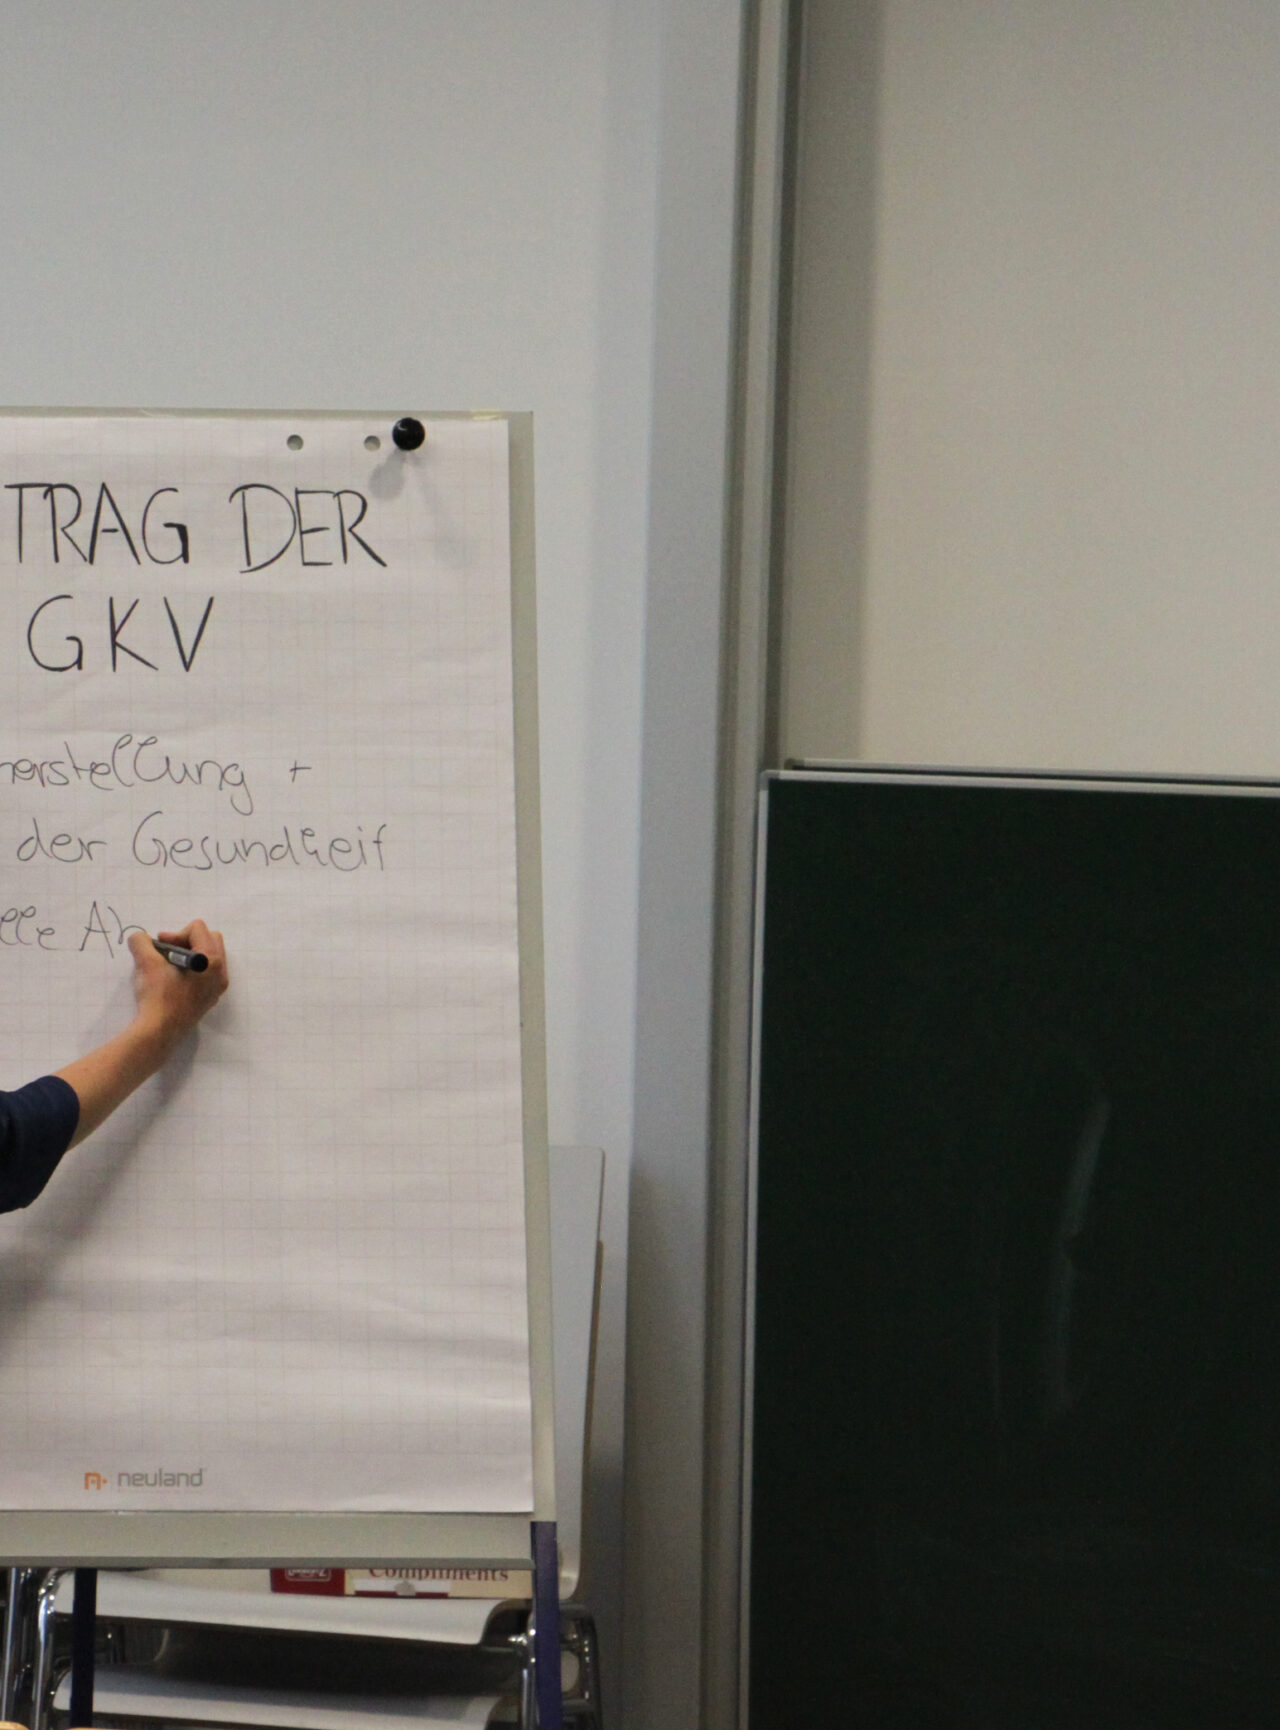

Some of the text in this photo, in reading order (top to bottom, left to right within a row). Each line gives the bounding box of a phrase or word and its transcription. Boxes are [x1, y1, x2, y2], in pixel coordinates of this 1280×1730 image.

[229, 483, 388, 573] DER
[27, 594, 215, 672] GKV
[17, 816, 108, 864] der
[132, 810, 388, 872] Gesundheit
[117, 1467, 204, 1488] neuland
